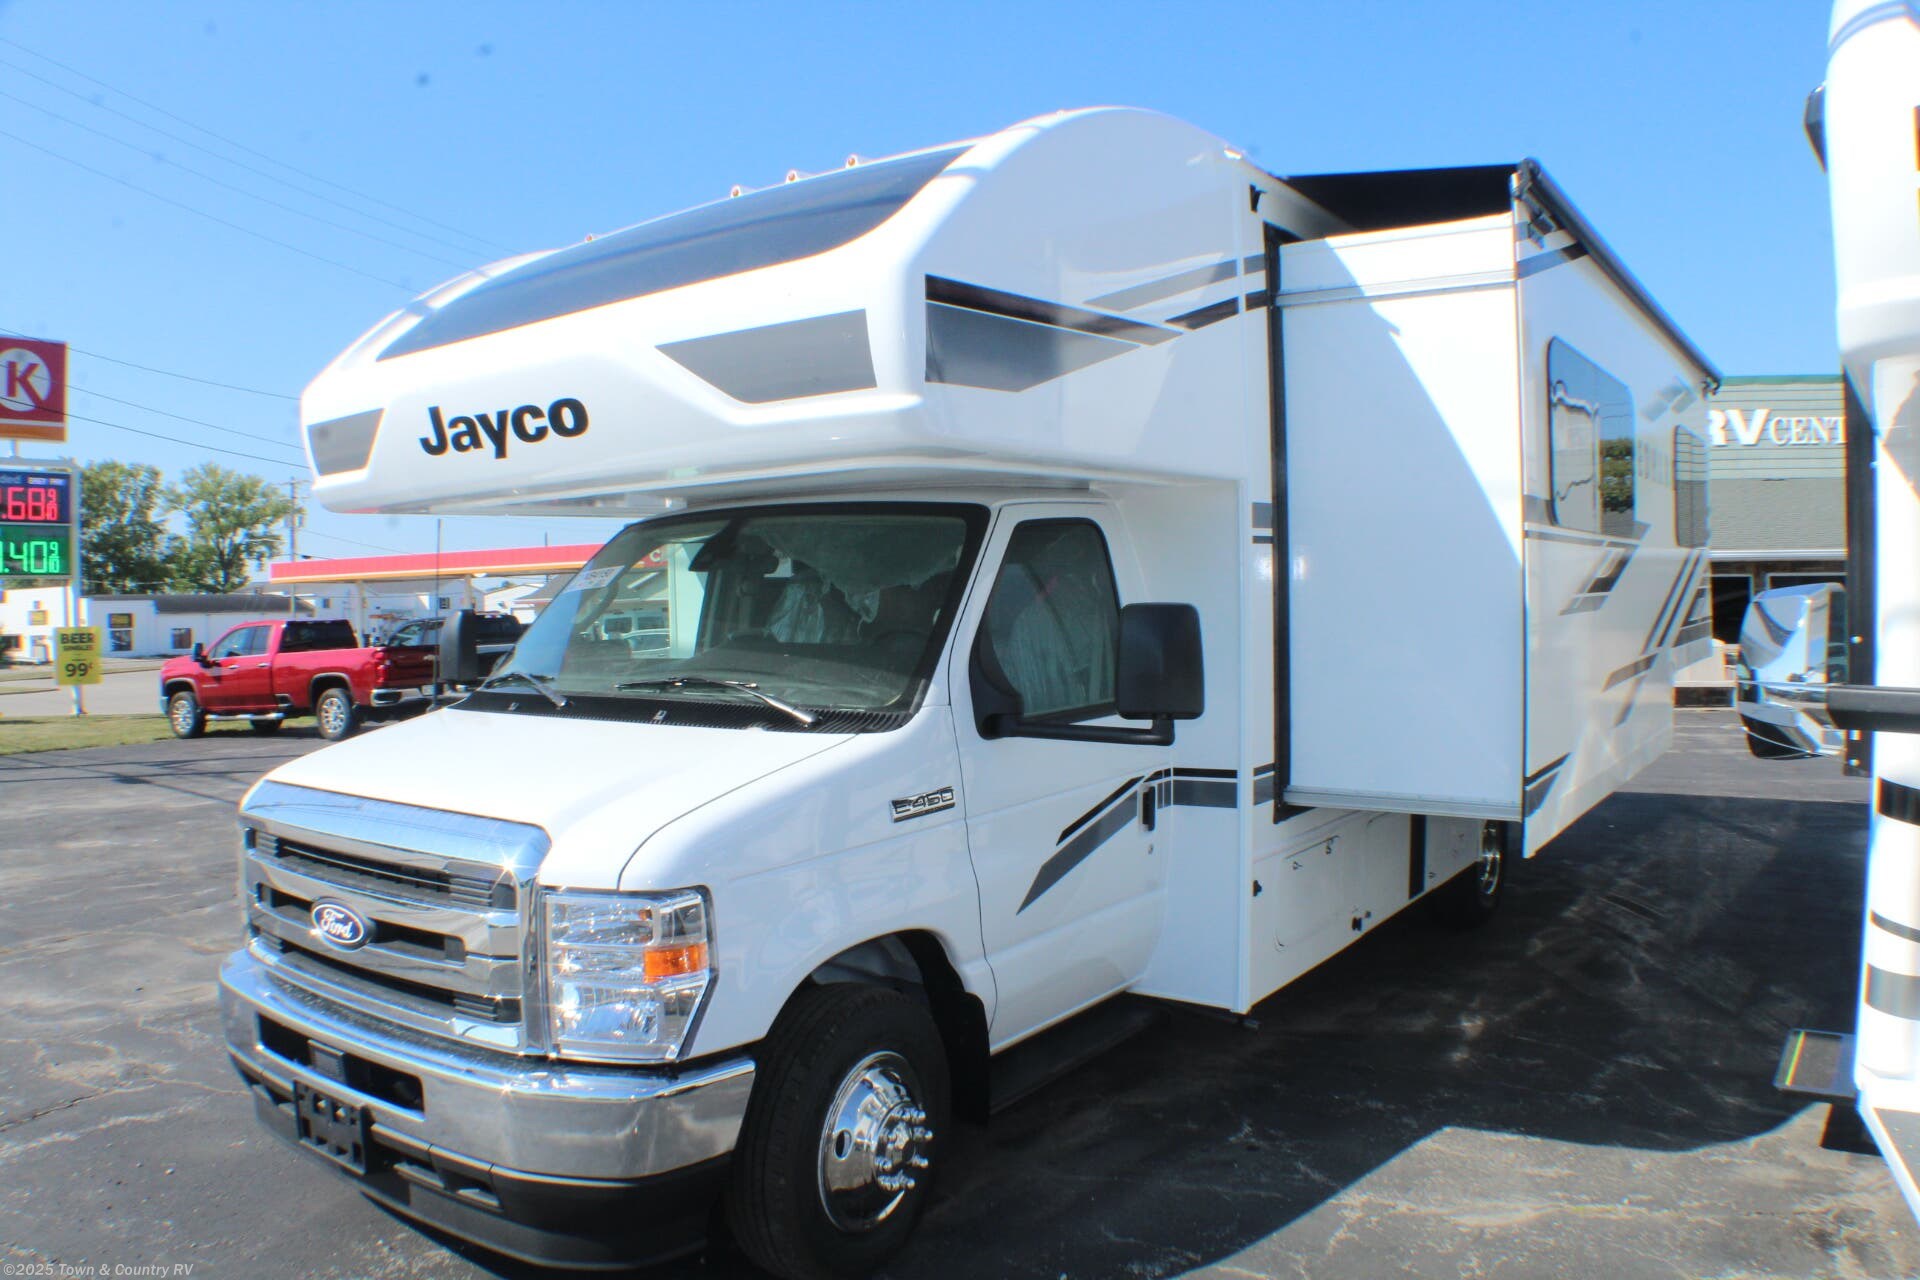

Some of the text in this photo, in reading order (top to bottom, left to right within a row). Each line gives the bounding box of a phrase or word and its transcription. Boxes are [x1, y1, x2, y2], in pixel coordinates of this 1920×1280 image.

[7, 361, 42, 406] K
[418, 397, 590, 459] Jayco
[61, 633, 96, 644] BEER
[321, 908, 354, 939] Ford
